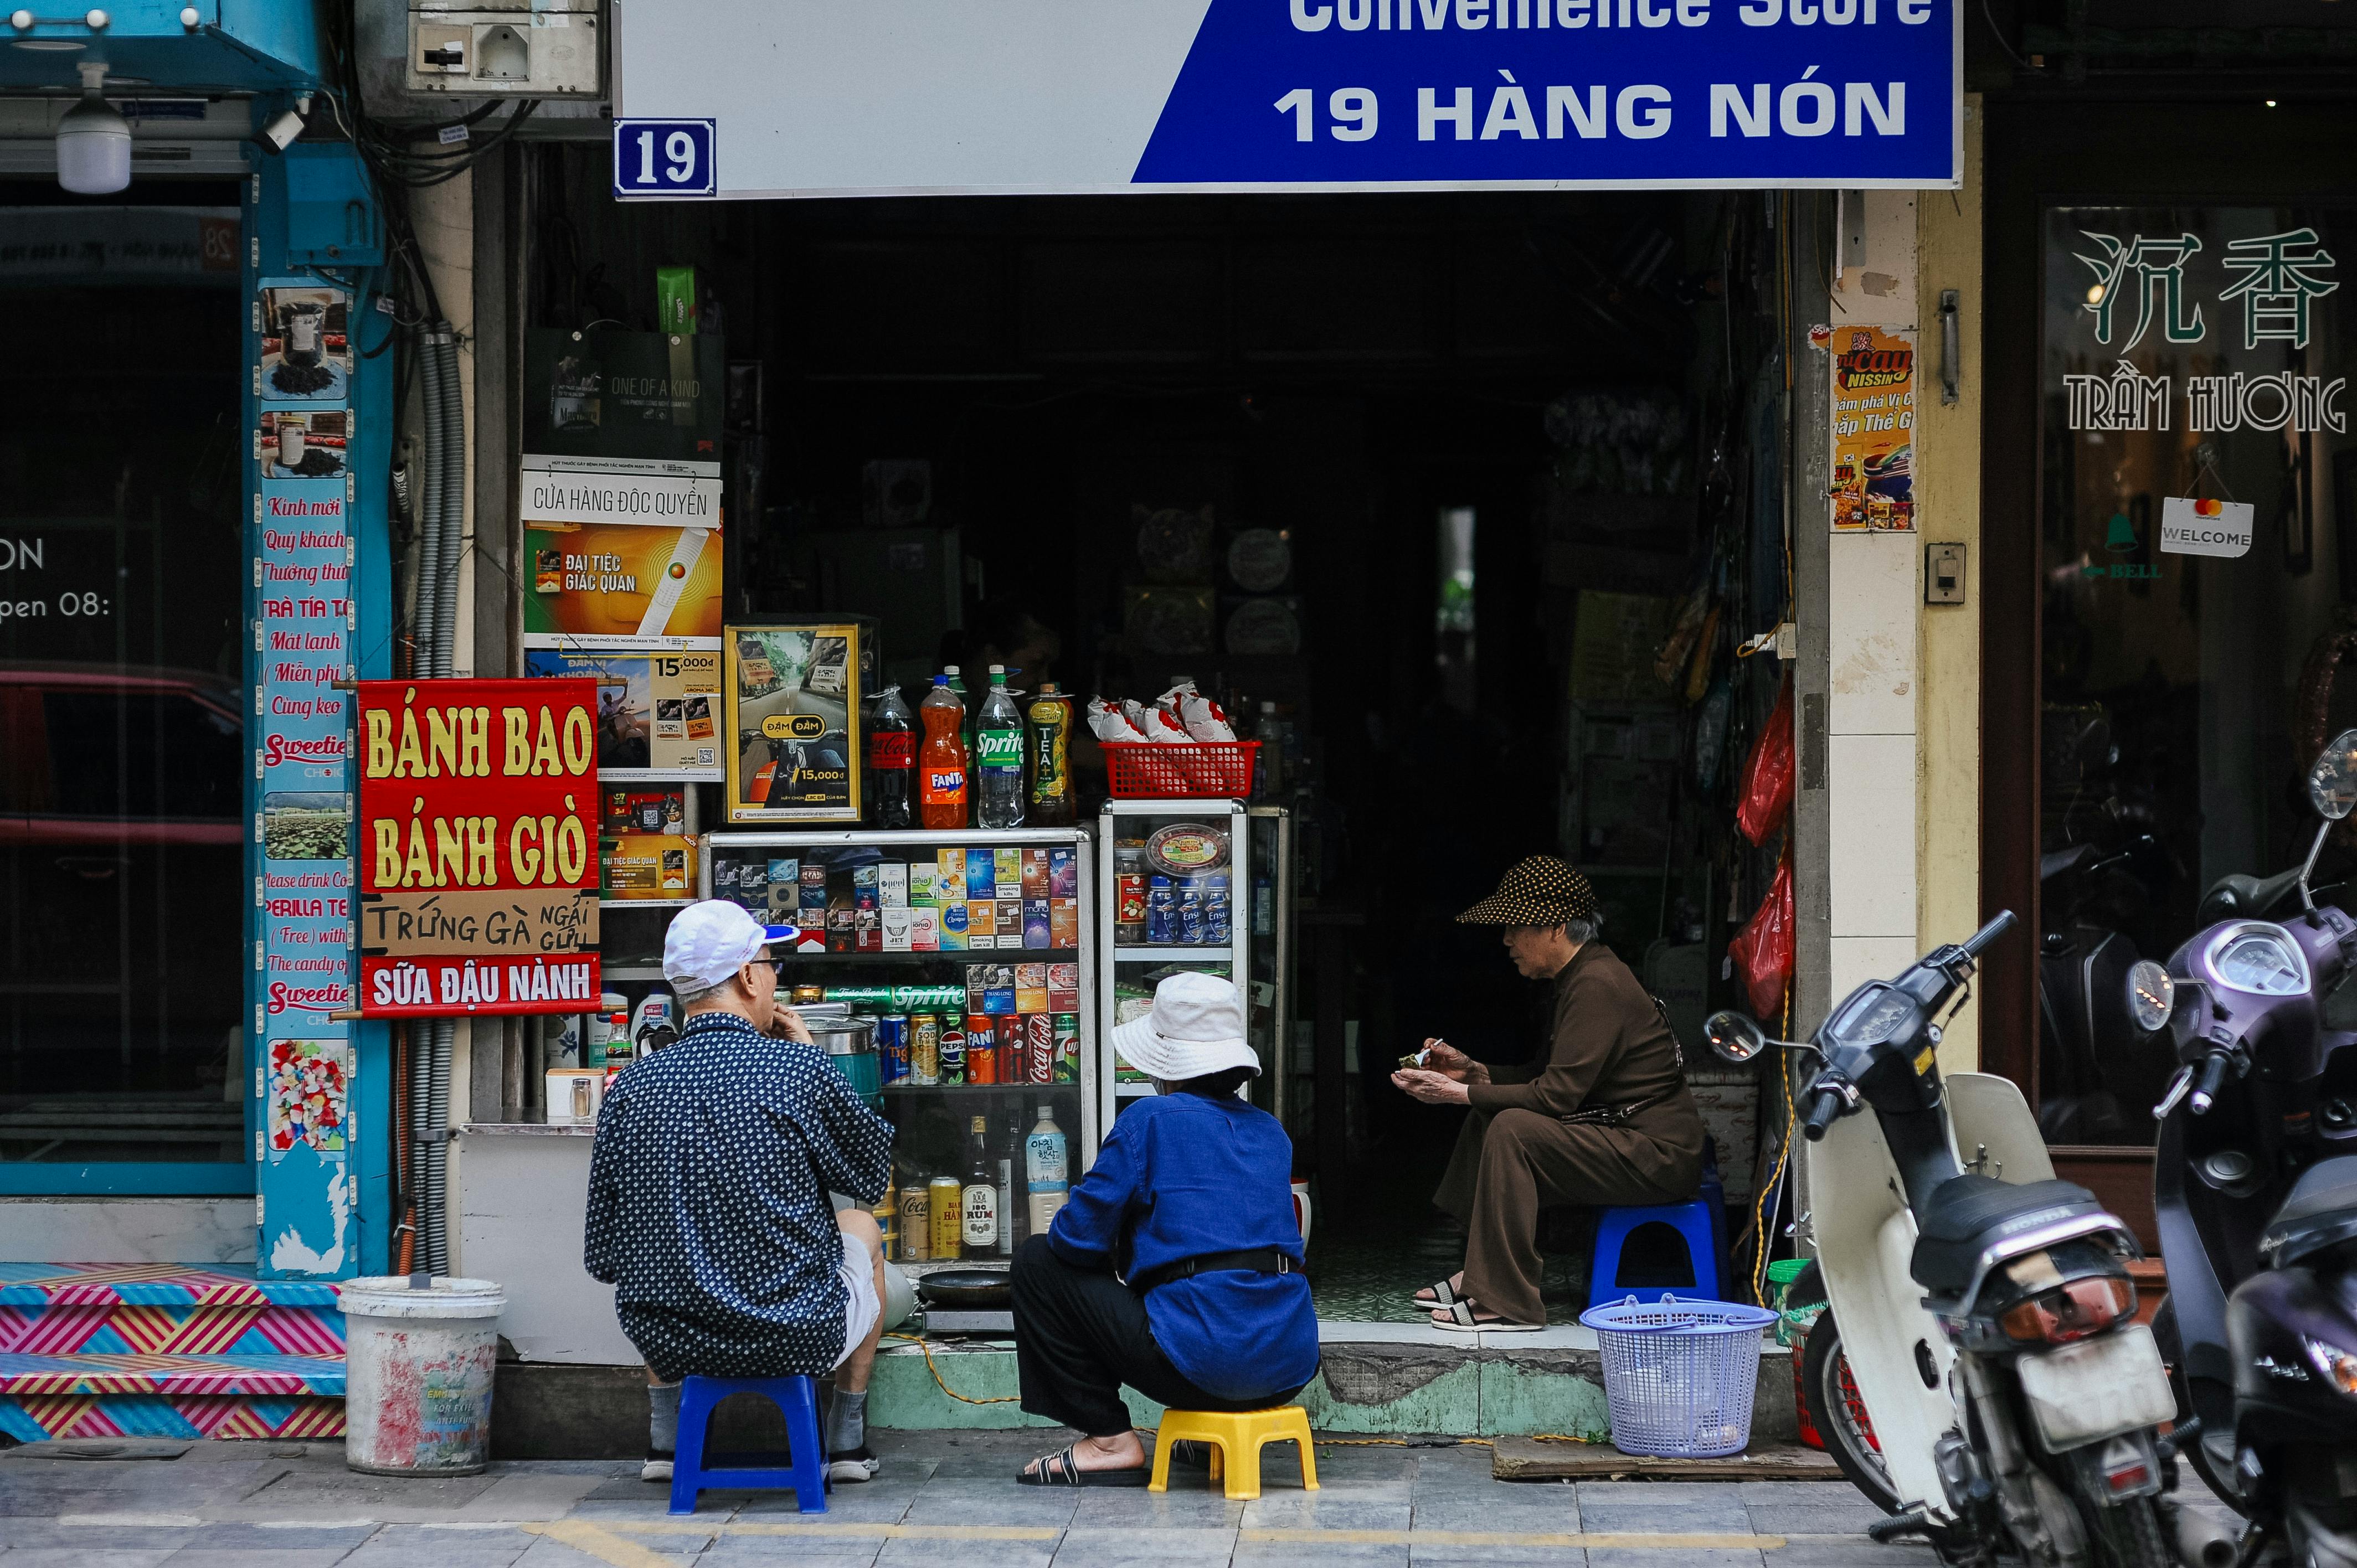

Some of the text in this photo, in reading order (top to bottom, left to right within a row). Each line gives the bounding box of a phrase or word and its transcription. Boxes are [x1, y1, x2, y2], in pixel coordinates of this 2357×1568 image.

[1274, 65, 1906, 142] 19 HÀNG NÓN
[637, 131, 695, 183] 19
[611, 376, 637, 395] ONE
[640, 378, 656, 396] OF
[659, 379, 668, 396] A
[671, 380, 700, 398] KIND
[1847, 373, 1893, 388] NISSIN
[1860, 394, 1885, 412] phá
[1888, 393, 1901, 410] Vị
[2063, 359, 2346, 434] TRẦM HƯƠNG
[1865, 410, 1898, 432] Thế
[267, 497, 341, 516] Kính mời
[533, 483, 707, 516] CỬA HÀNG ĐỘC QUYỀN
[264, 530, 345, 554] Quý khách
[2163, 527, 2251, 546] WELCOME
[263, 562, 348, 586] Thưởng thứ
[565, 551, 621, 574] ĐẠI TIỆC
[2110, 563, 2163, 579] BELL
[565, 570, 636, 594] GIÁC QUAN
[59, 592, 109, 616] 08:
[263, 596, 294, 618] TRÀ
[297, 596, 326, 618] TÍA
[270, 631, 342, 653] Mát lạnh
[274, 661, 341, 688] Miễn phí
[655, 657, 714, 677] 15,000đ
[271, 695, 342, 720] Cùng kẹo
[365, 687, 593, 778] BÁNH BAO
[977, 731, 1024, 757] Sprite
[264, 734, 346, 767] Sweetie
[932, 771, 964, 787] FANTA
[373, 794, 587, 888] BÁNH GIÒ
[298, 872, 330, 888] drink
[366, 894, 590, 946] TRỨNG GÀ NGẢI
[280, 926, 347, 943] Free with
[267, 955, 292, 972] The
[294, 956, 336, 976] candy
[373, 957, 591, 1011] SỮA ĐẬU NÀNH
[267, 981, 348, 1014] Sweetie
[895, 986, 966, 1010] Sprite
[1031, 1138, 1053, 1151] 아침
[1037, 1149, 1058, 1160] 햇살
[966, 1210, 993, 1219] RUM
[434, 1404, 451, 1413] FOR
